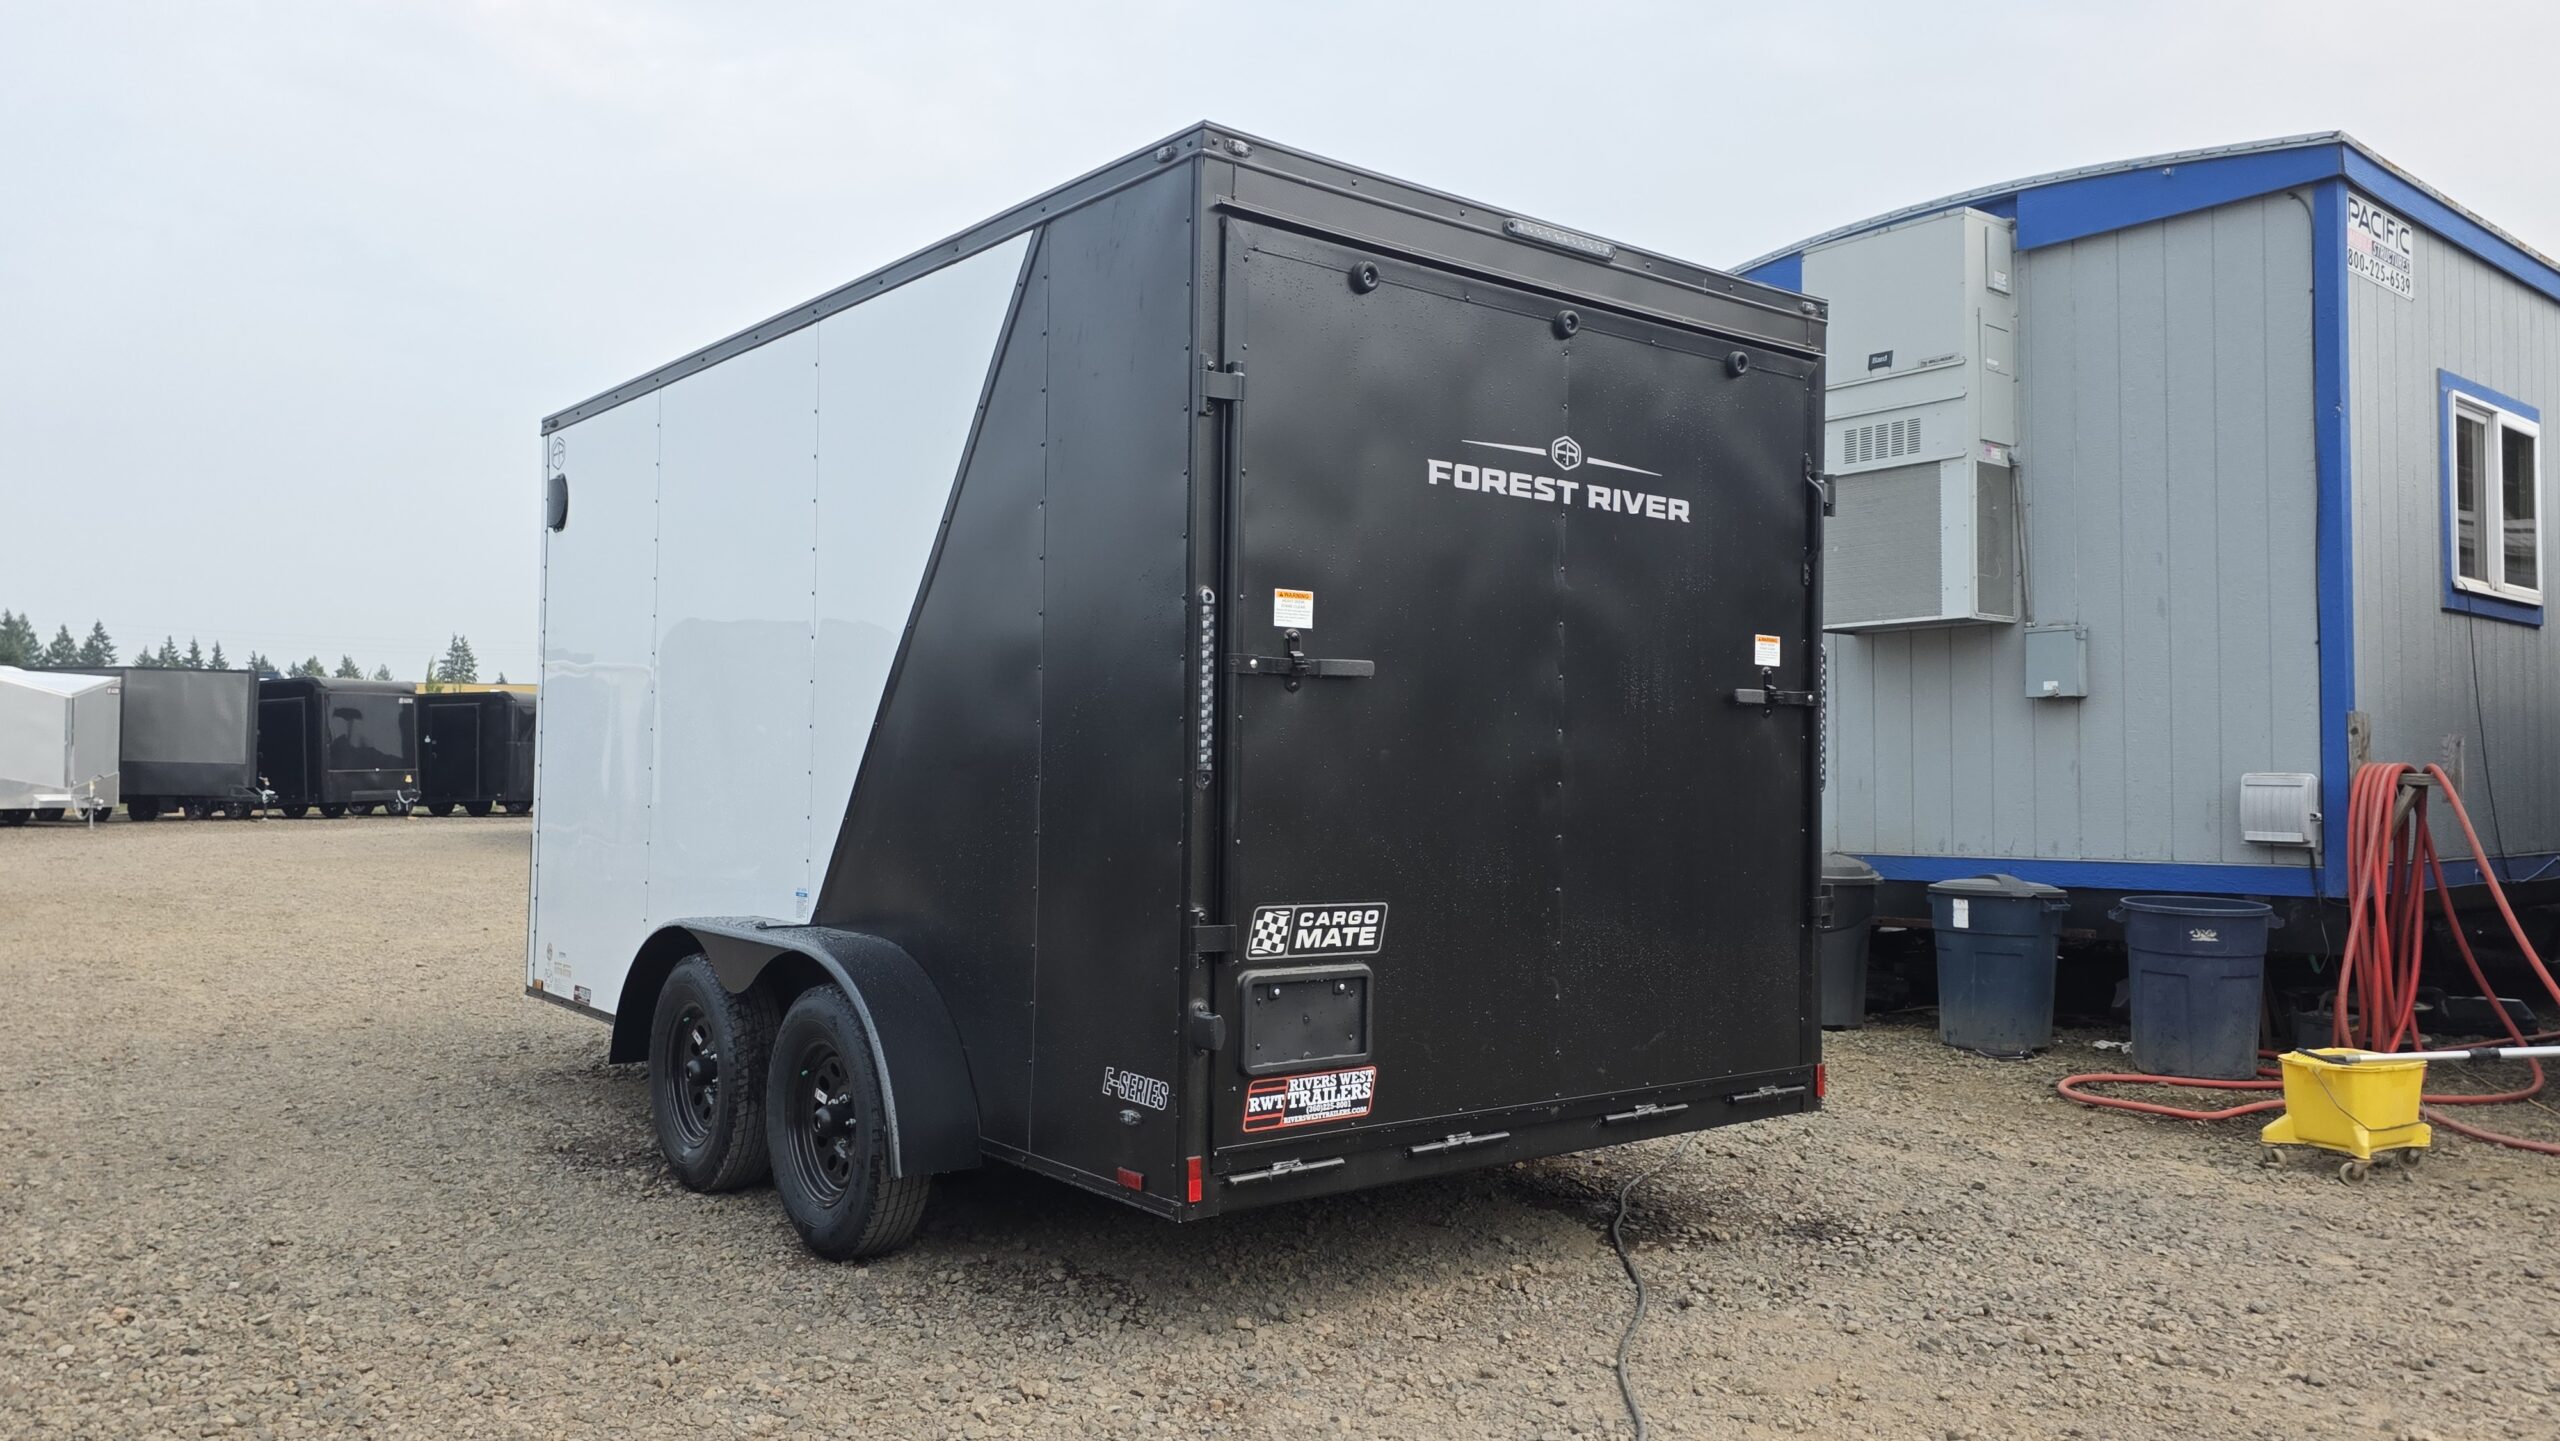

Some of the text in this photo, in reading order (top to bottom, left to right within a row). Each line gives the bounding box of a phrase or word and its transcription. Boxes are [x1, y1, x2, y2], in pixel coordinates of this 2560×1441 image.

[2348, 248, 2411, 295] 800-225-6539
[1427, 459, 1690, 523] FOREST RIVER
[1299, 910, 1379, 927] CARGO
[1295, 926, 1377, 949] MATE
[1102, 1066, 1169, 1111] E-SERIES
[1289, 1069, 1375, 1092] RIVERS WEST
[1248, 1094, 1285, 1113] RWT
[1287, 1083, 1371, 1109] TRAILERS
